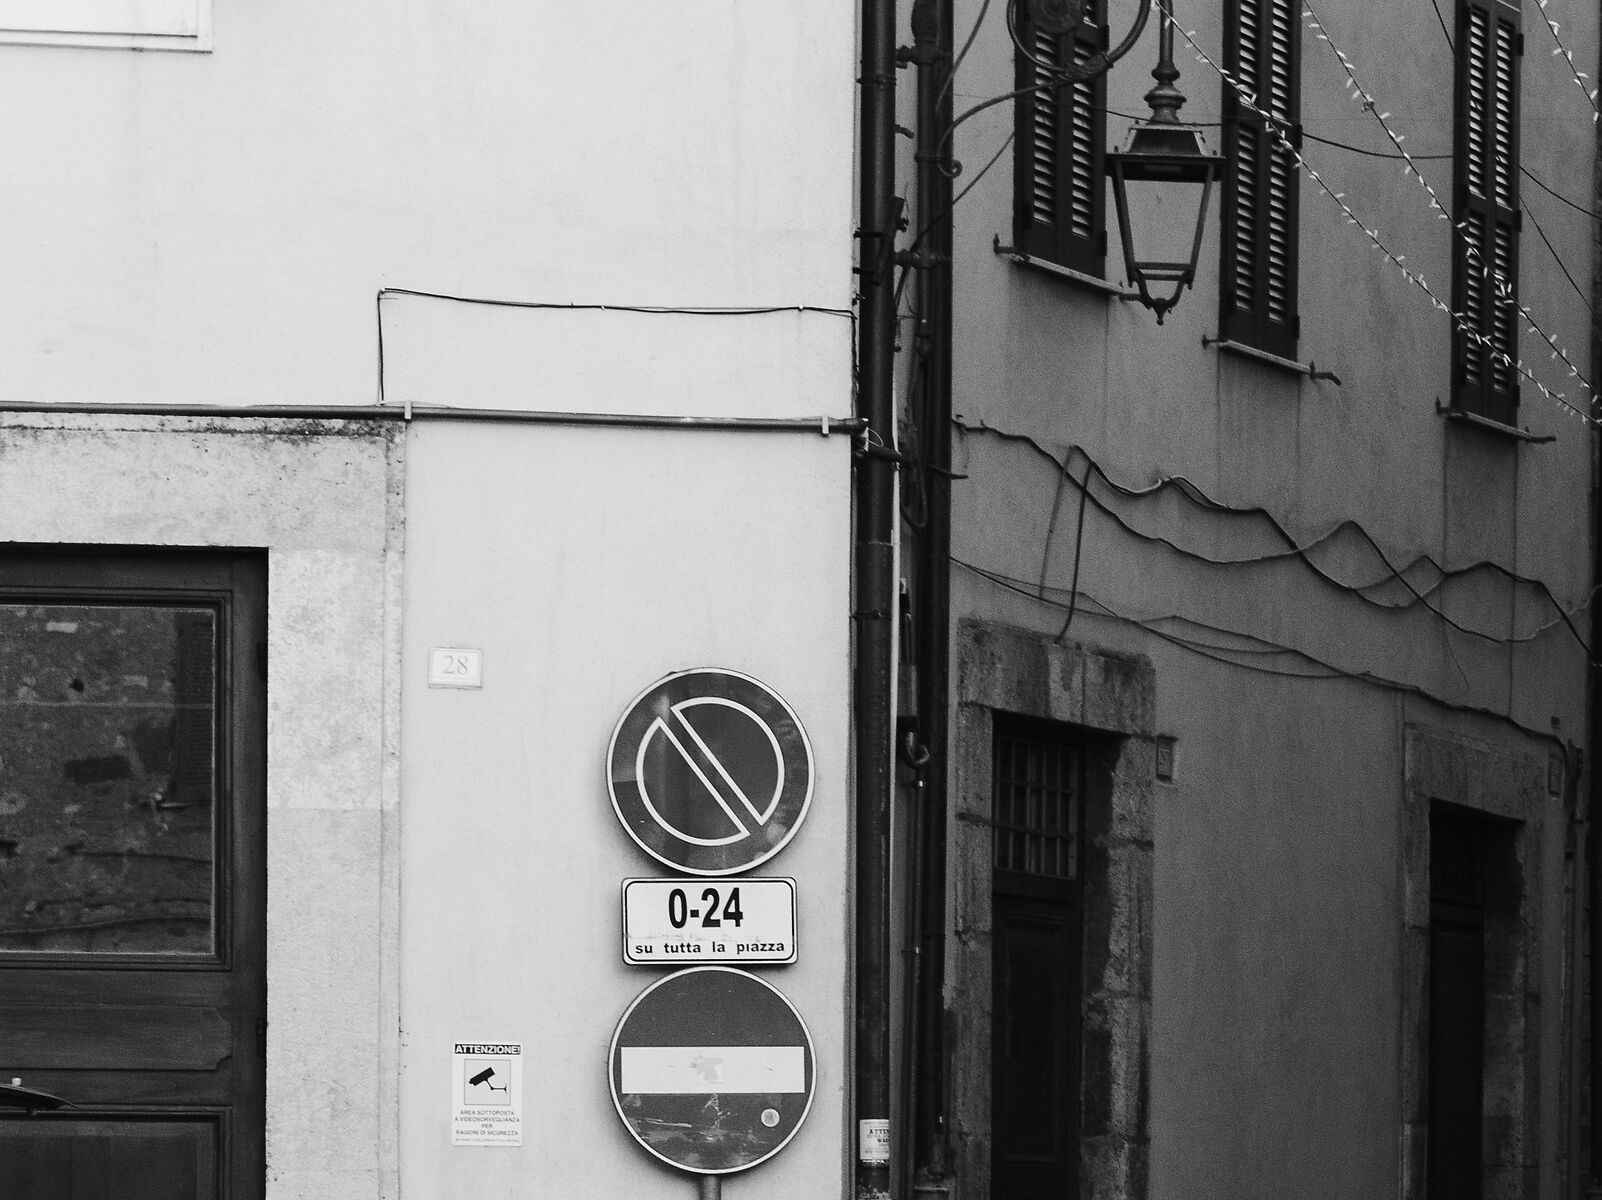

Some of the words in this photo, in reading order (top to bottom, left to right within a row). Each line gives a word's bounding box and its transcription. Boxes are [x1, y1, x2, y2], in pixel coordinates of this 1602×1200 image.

[442, 655, 468, 675] 28
[668, 887, 744, 929] 0-24
[635, 944, 653, 954] su
[664, 942, 701, 953] tutta
[712, 941, 726, 953] la
[736, 942, 785, 955] piazza
